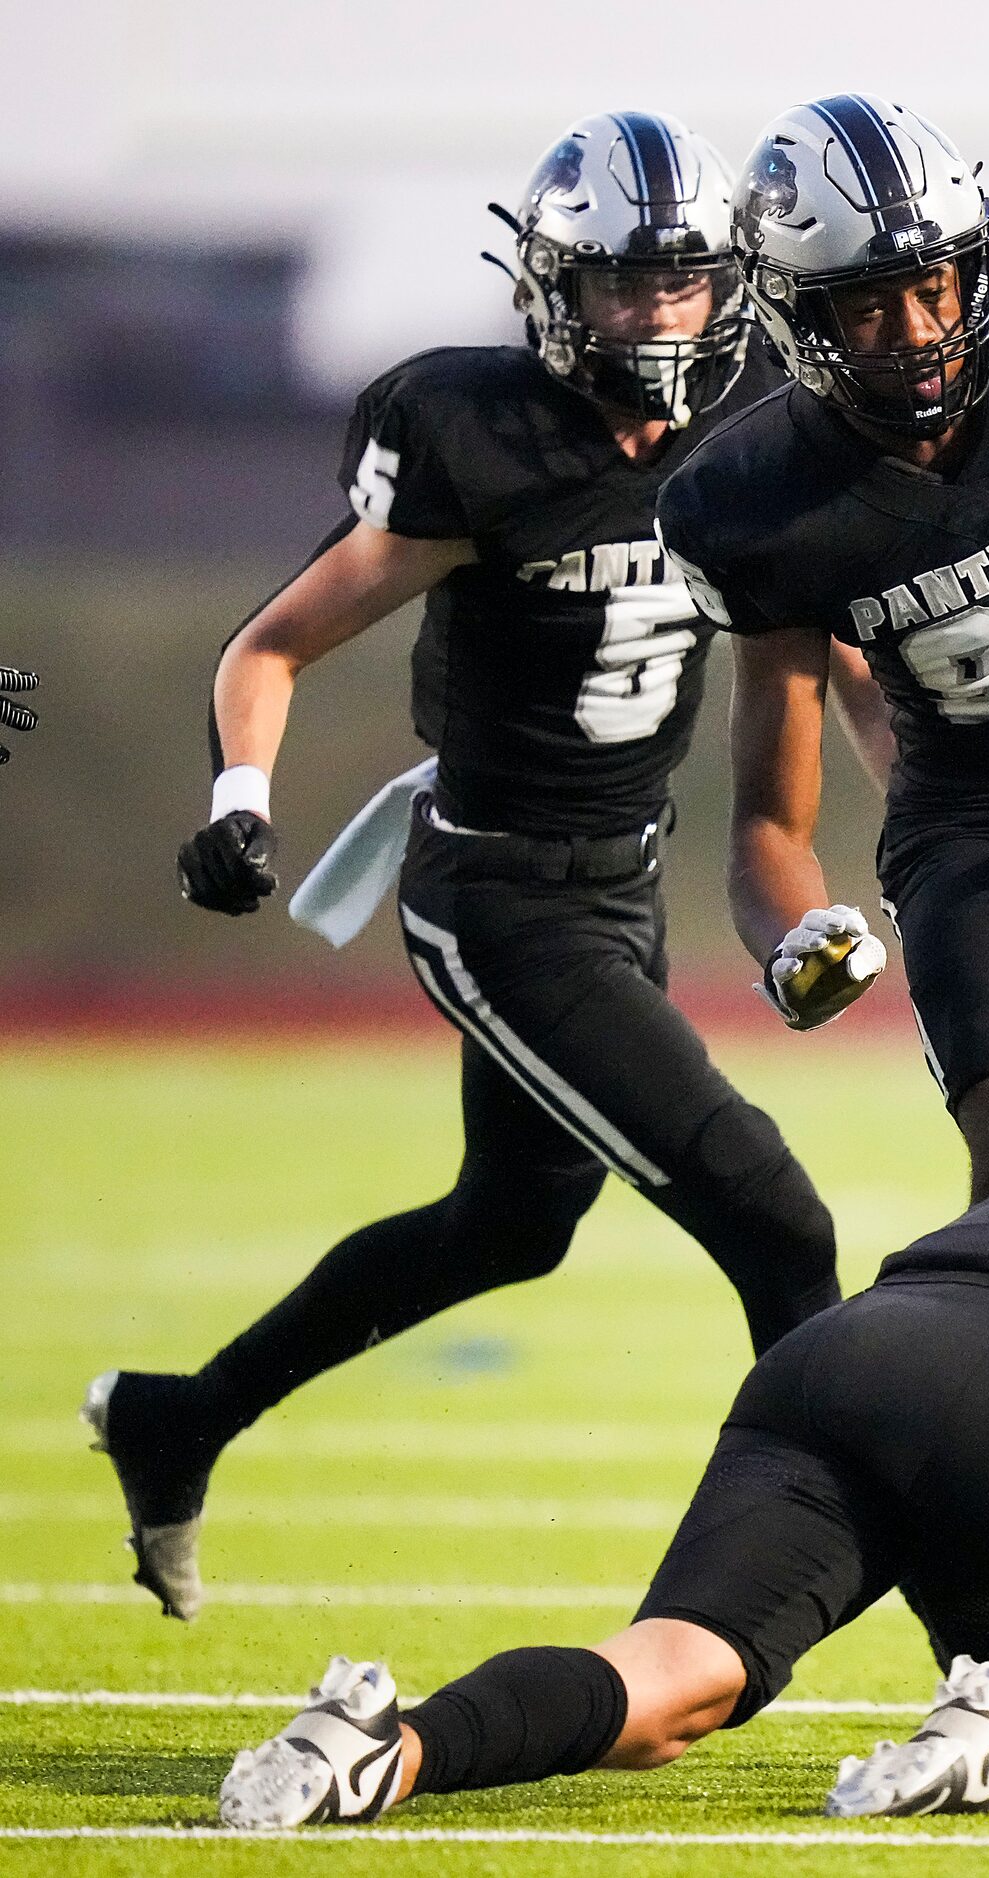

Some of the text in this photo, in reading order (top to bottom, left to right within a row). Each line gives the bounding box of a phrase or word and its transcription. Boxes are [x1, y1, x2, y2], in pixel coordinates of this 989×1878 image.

[967, 273, 989, 328] Riddell
[349, 437, 401, 531] 5
[574, 582, 698, 744] 5
